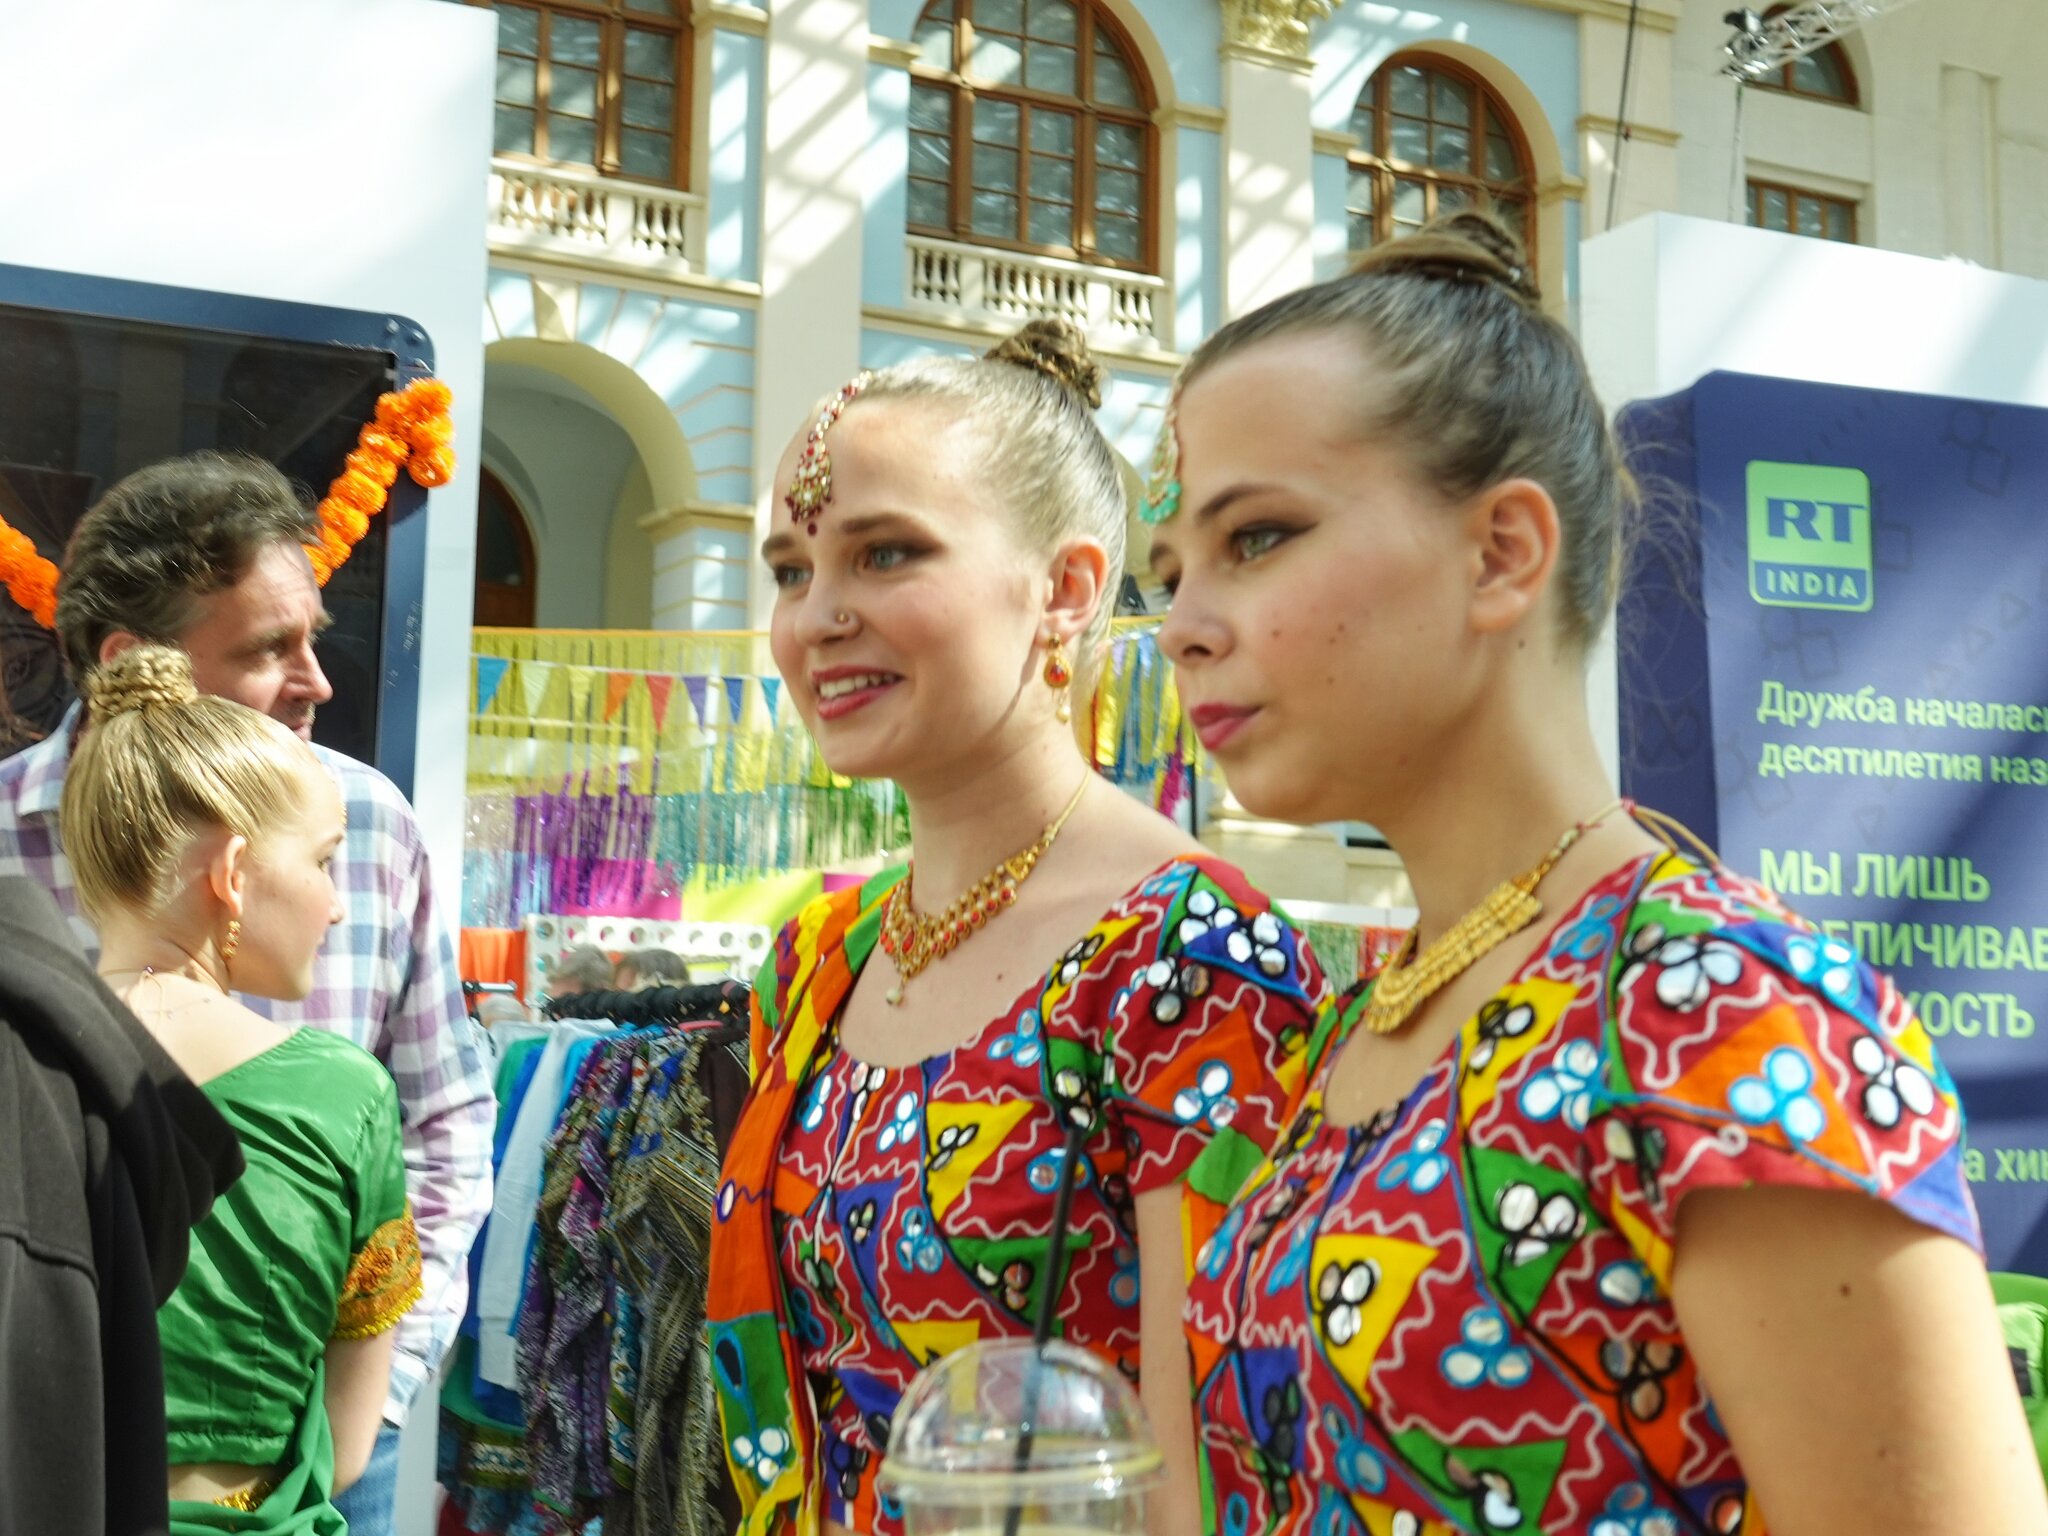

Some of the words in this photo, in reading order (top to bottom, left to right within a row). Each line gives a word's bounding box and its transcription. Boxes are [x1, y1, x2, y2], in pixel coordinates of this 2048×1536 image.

[1766, 496, 1867, 544] RT
[1767, 568, 1860, 600] INDIA
[1756, 680, 1898, 728] Дружба
[1905, 697, 2048, 733] началас
[1758, 742, 1983, 783] десятилетия
[1760, 848, 1842, 897] МЫ
[1852, 852, 1992, 903] ЛИШЬ
[1905, 990, 2036, 1039] ОСТЬ
